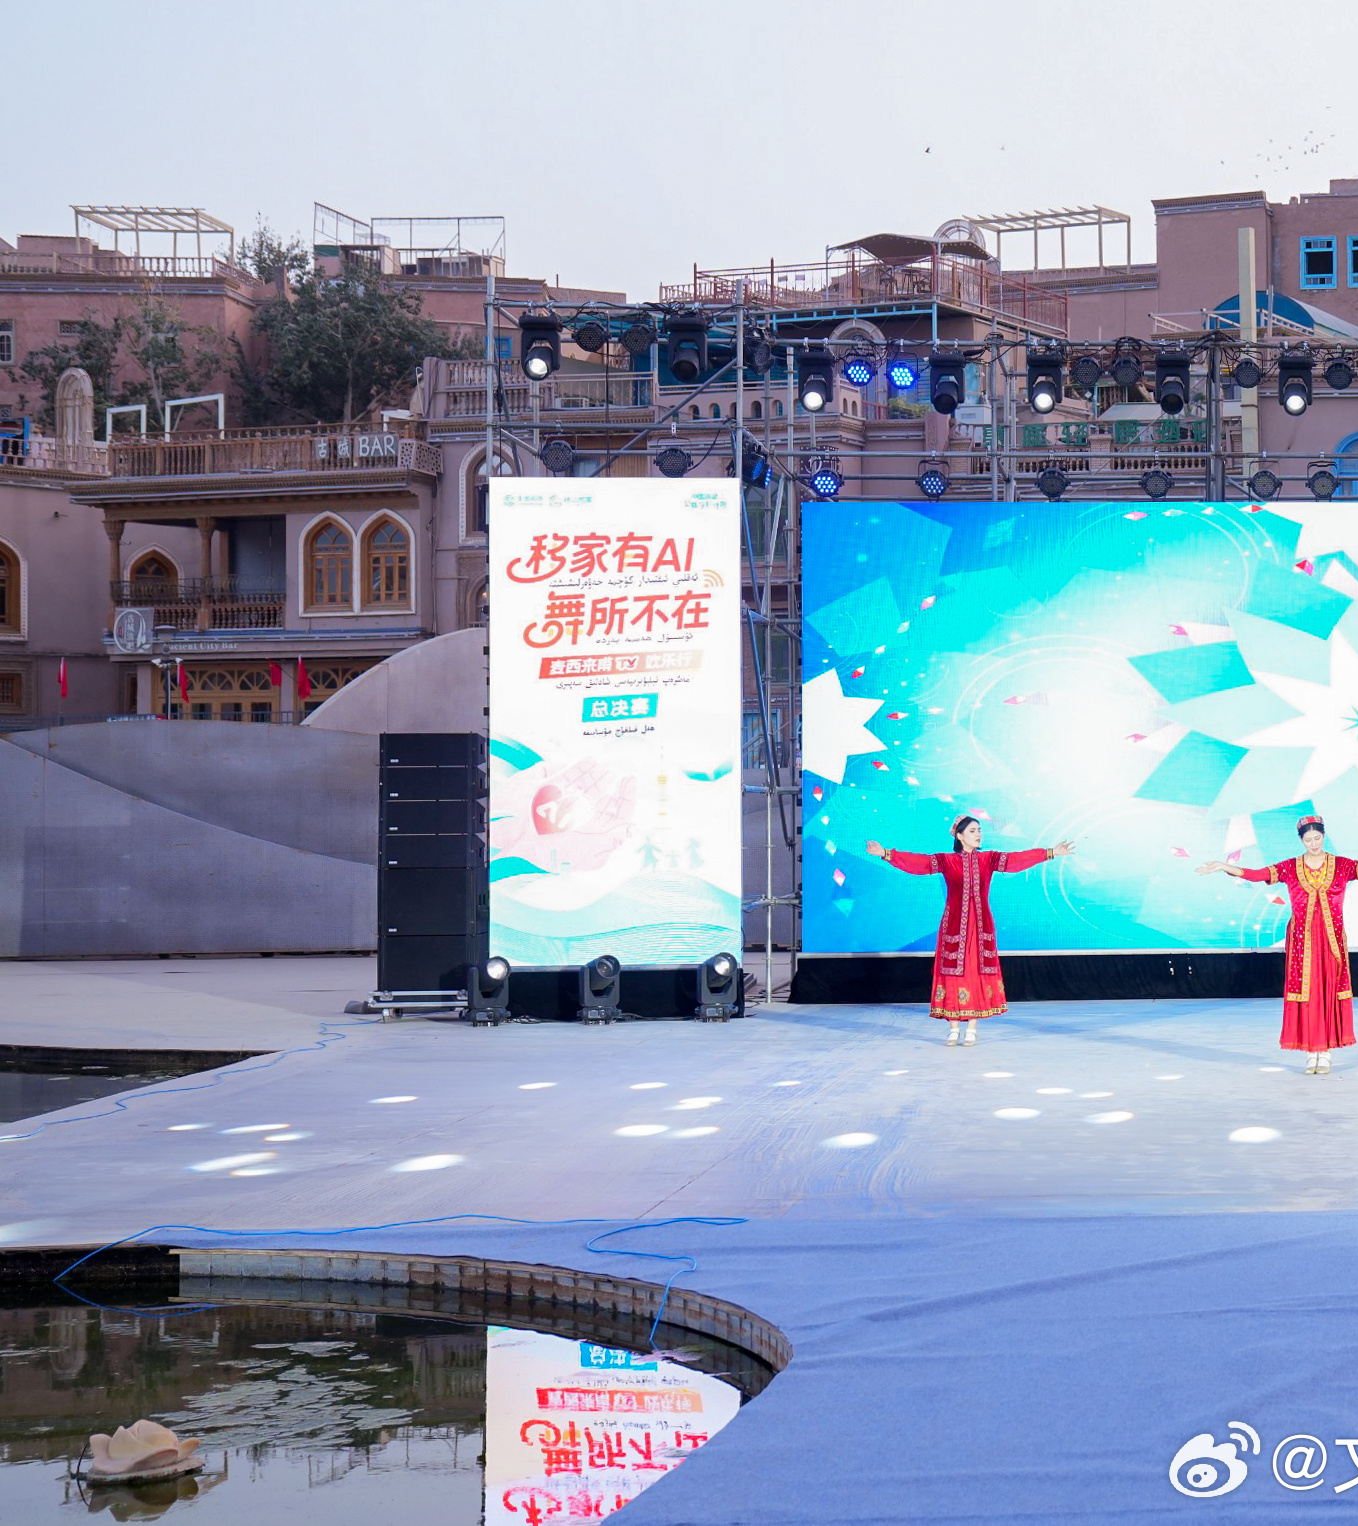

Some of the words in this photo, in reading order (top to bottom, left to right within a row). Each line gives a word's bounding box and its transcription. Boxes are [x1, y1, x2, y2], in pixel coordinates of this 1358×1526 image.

[359, 435, 396, 457] BAR
[506, 531, 695, 584] 移家有AI
[523, 589, 712, 649] 舞所不在
[164, 641, 198, 651] ncient
[221, 641, 239, 650] Bar
[590, 697, 650, 718] 总决赛
